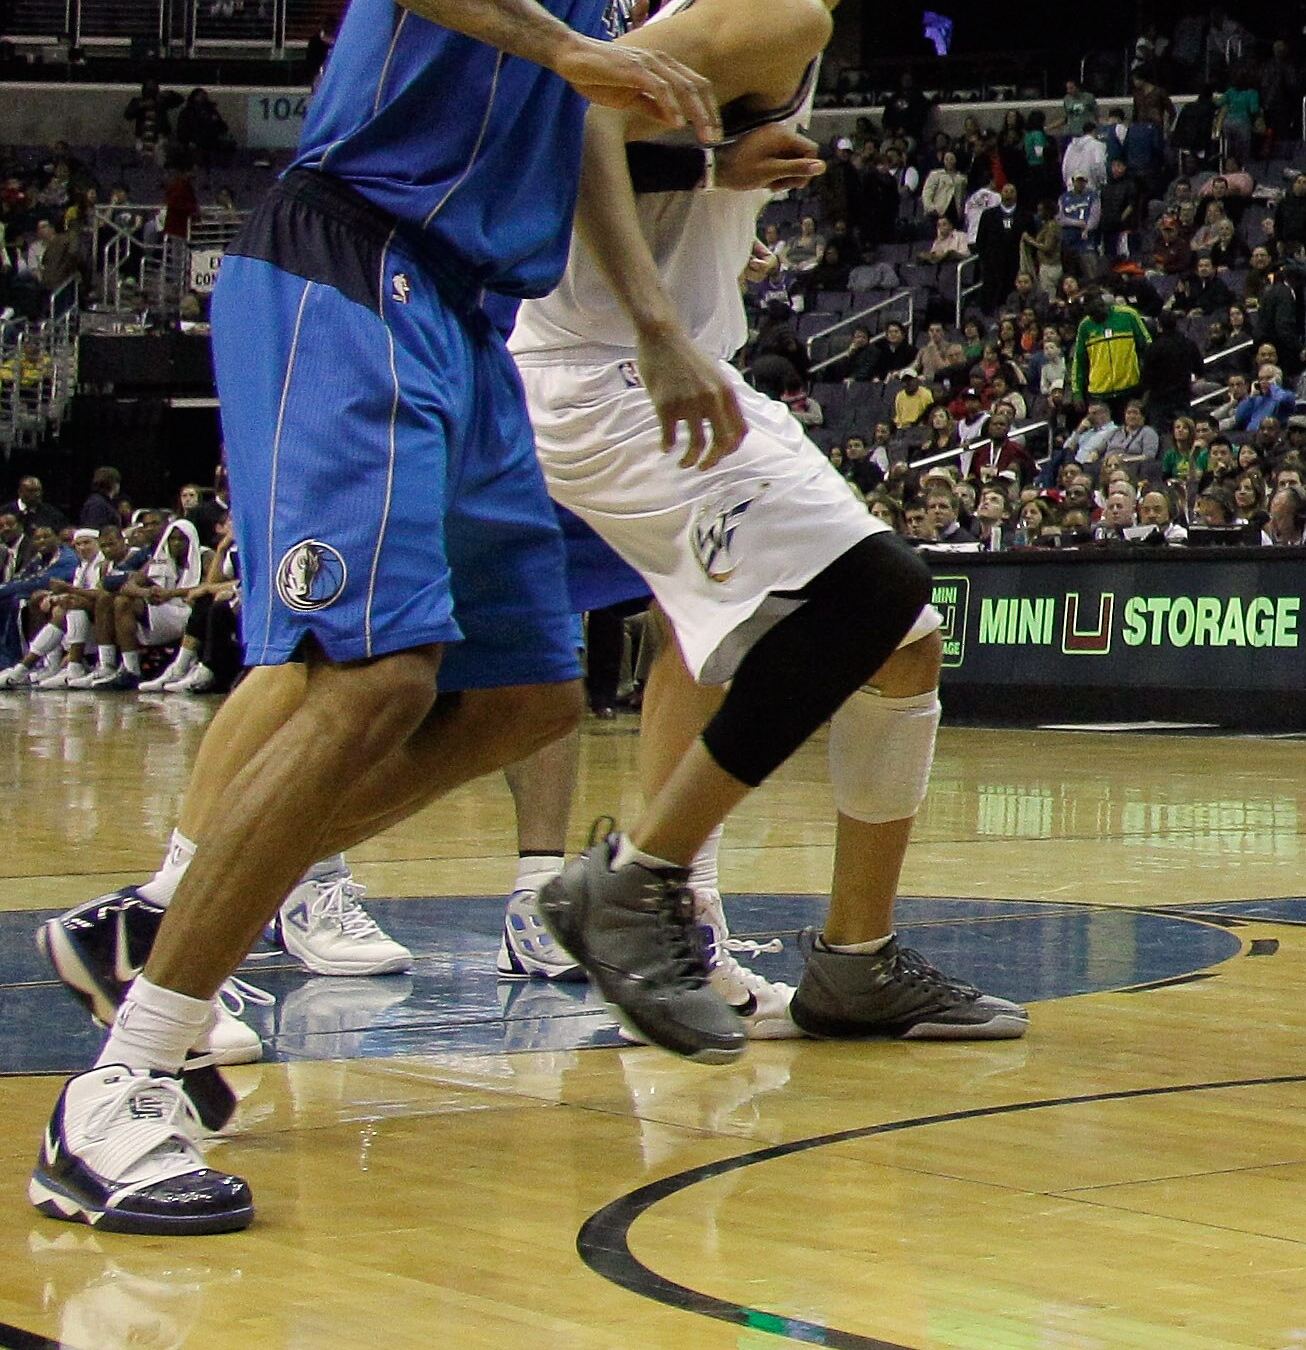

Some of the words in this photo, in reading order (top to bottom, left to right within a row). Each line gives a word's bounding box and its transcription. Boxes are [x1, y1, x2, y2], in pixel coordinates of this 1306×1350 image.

[932, 587, 957, 603] MINI
[978, 598, 1055, 645] MINI
[1061, 592, 1115, 654] U
[1122, 596, 1300, 648] STORAGE
